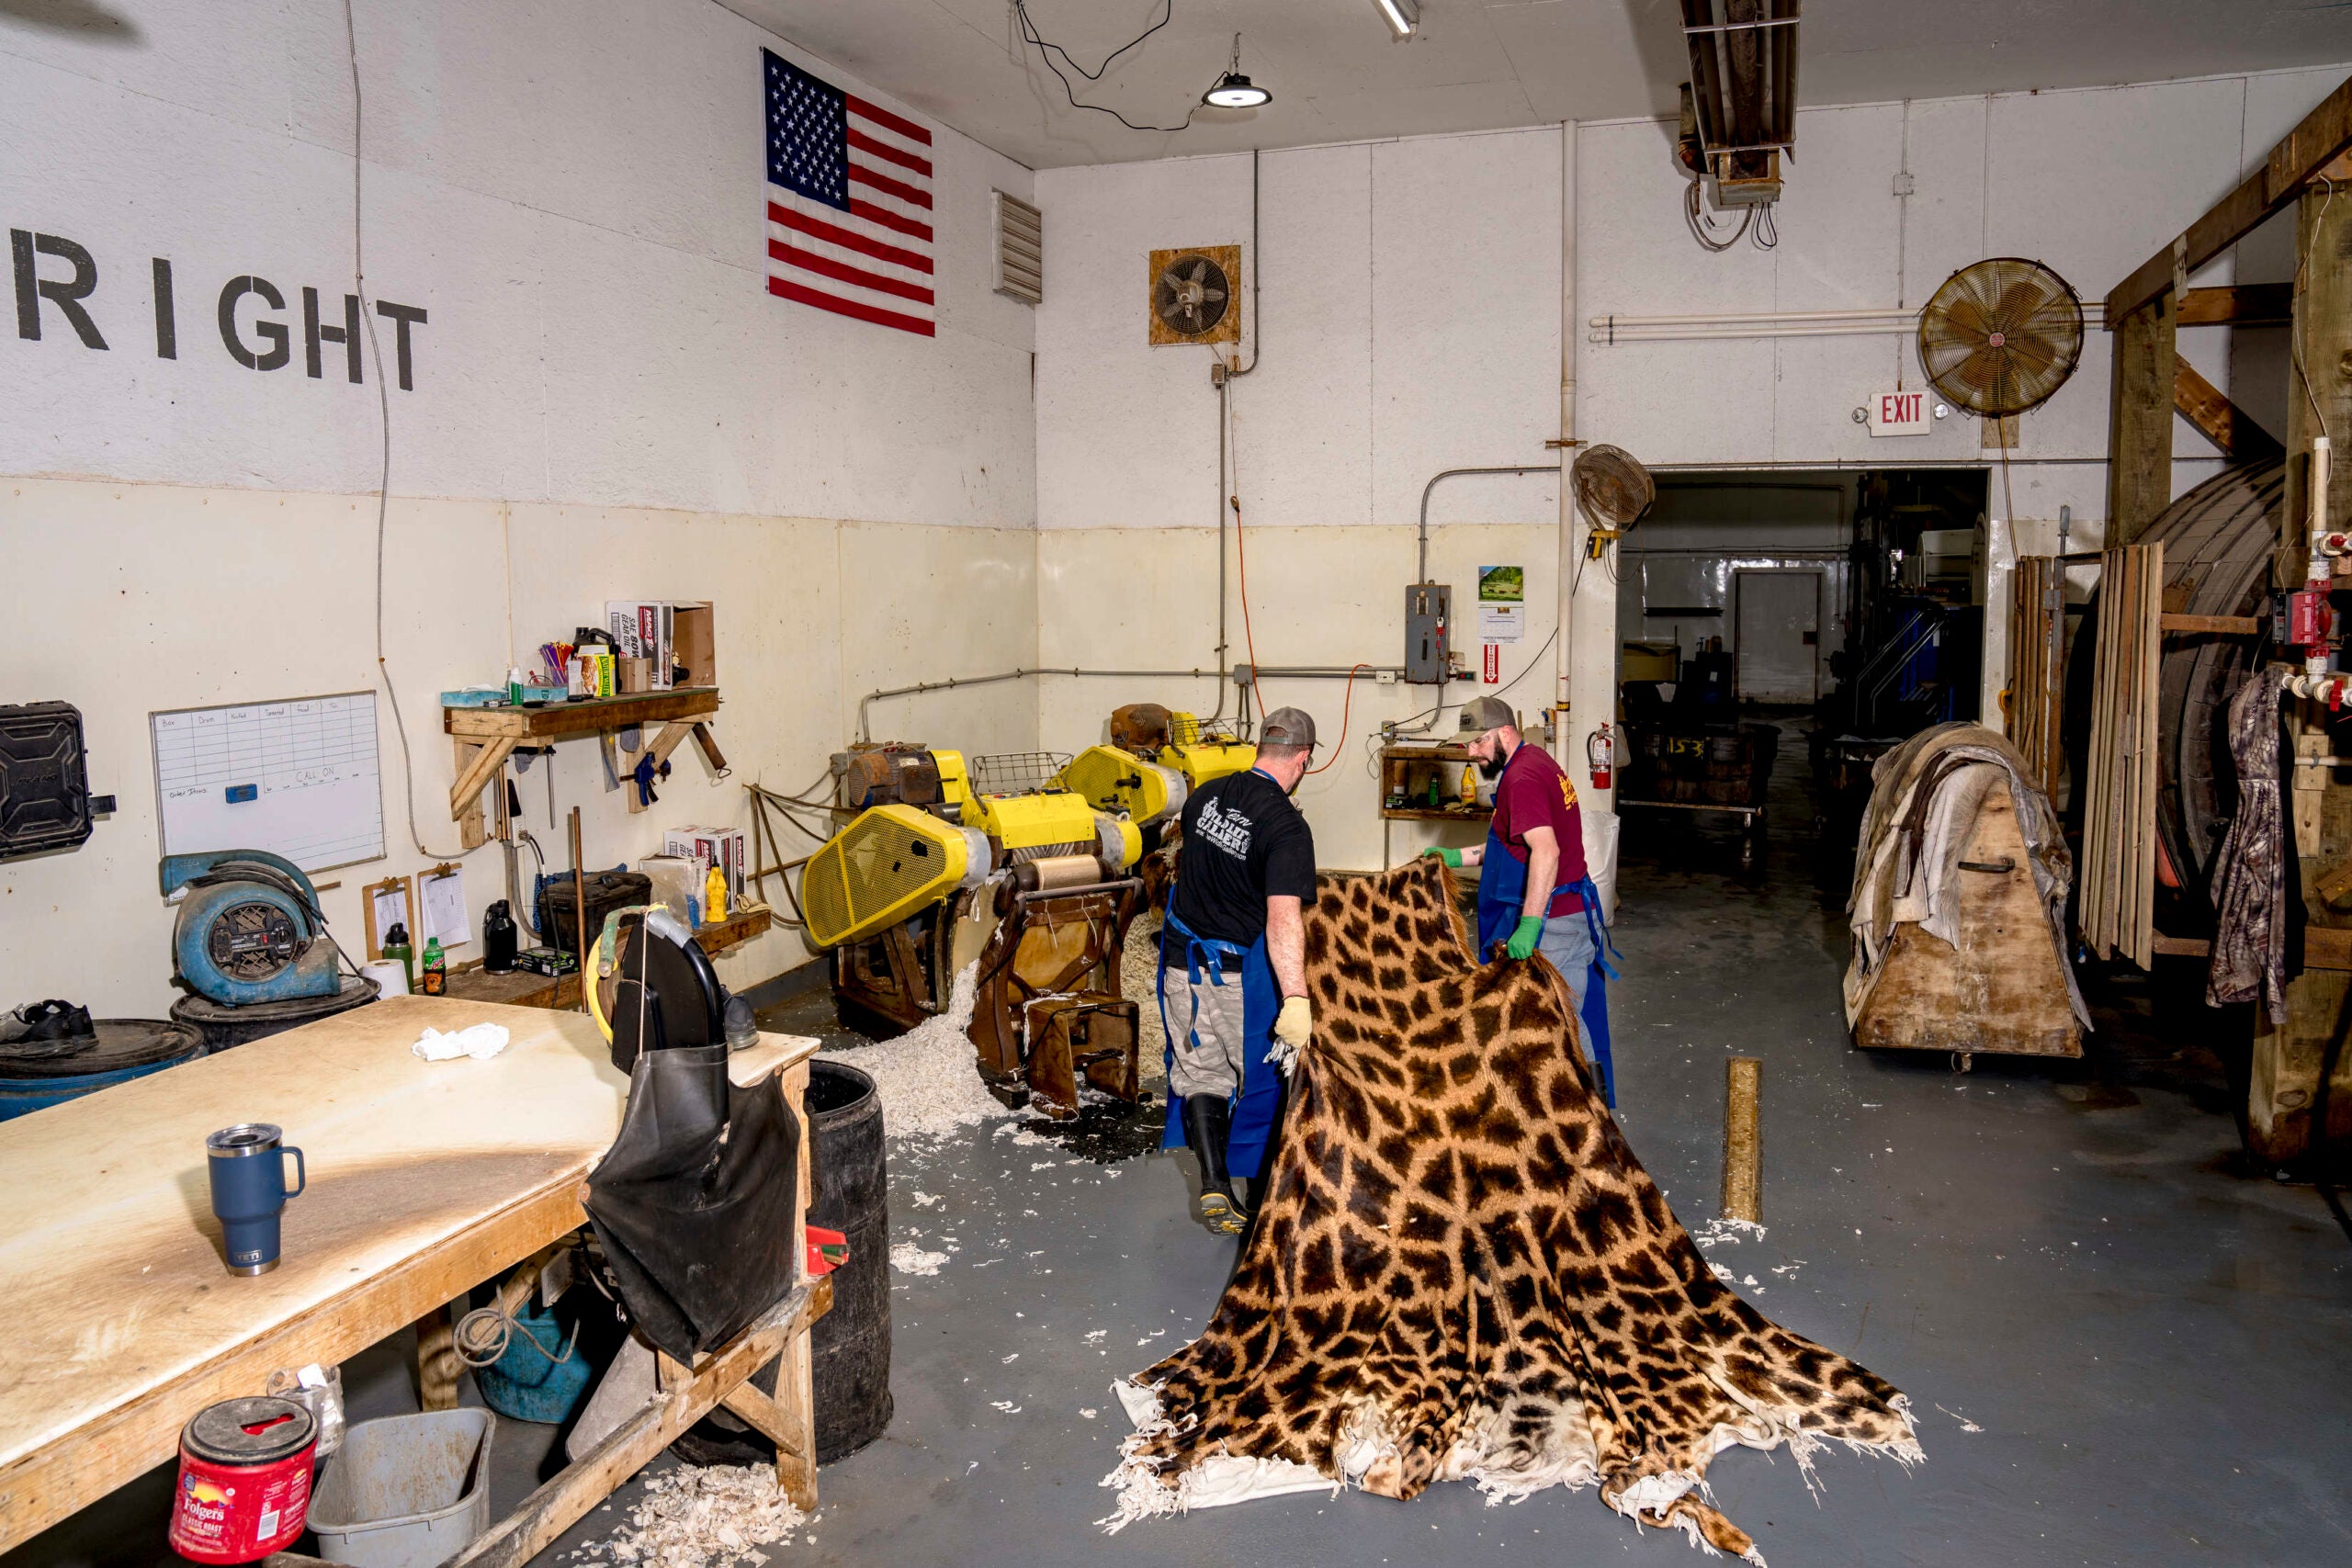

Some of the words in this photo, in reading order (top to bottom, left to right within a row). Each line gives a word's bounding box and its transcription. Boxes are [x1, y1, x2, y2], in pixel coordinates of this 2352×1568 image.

[10, 228, 427, 391] RIGHT
[1882, 393, 1923, 423] EXIT
[621, 614, 630, 635] GEAR
[628, 617, 637, 634] SAE
[1202, 803, 1250, 840] WILDLIF
[1226, 807, 1253, 827] Team
[236, 1252, 260, 1261] YETI
[184, 1498, 224, 1521] Folgers
[203, 1522, 223, 1534] ROAST
